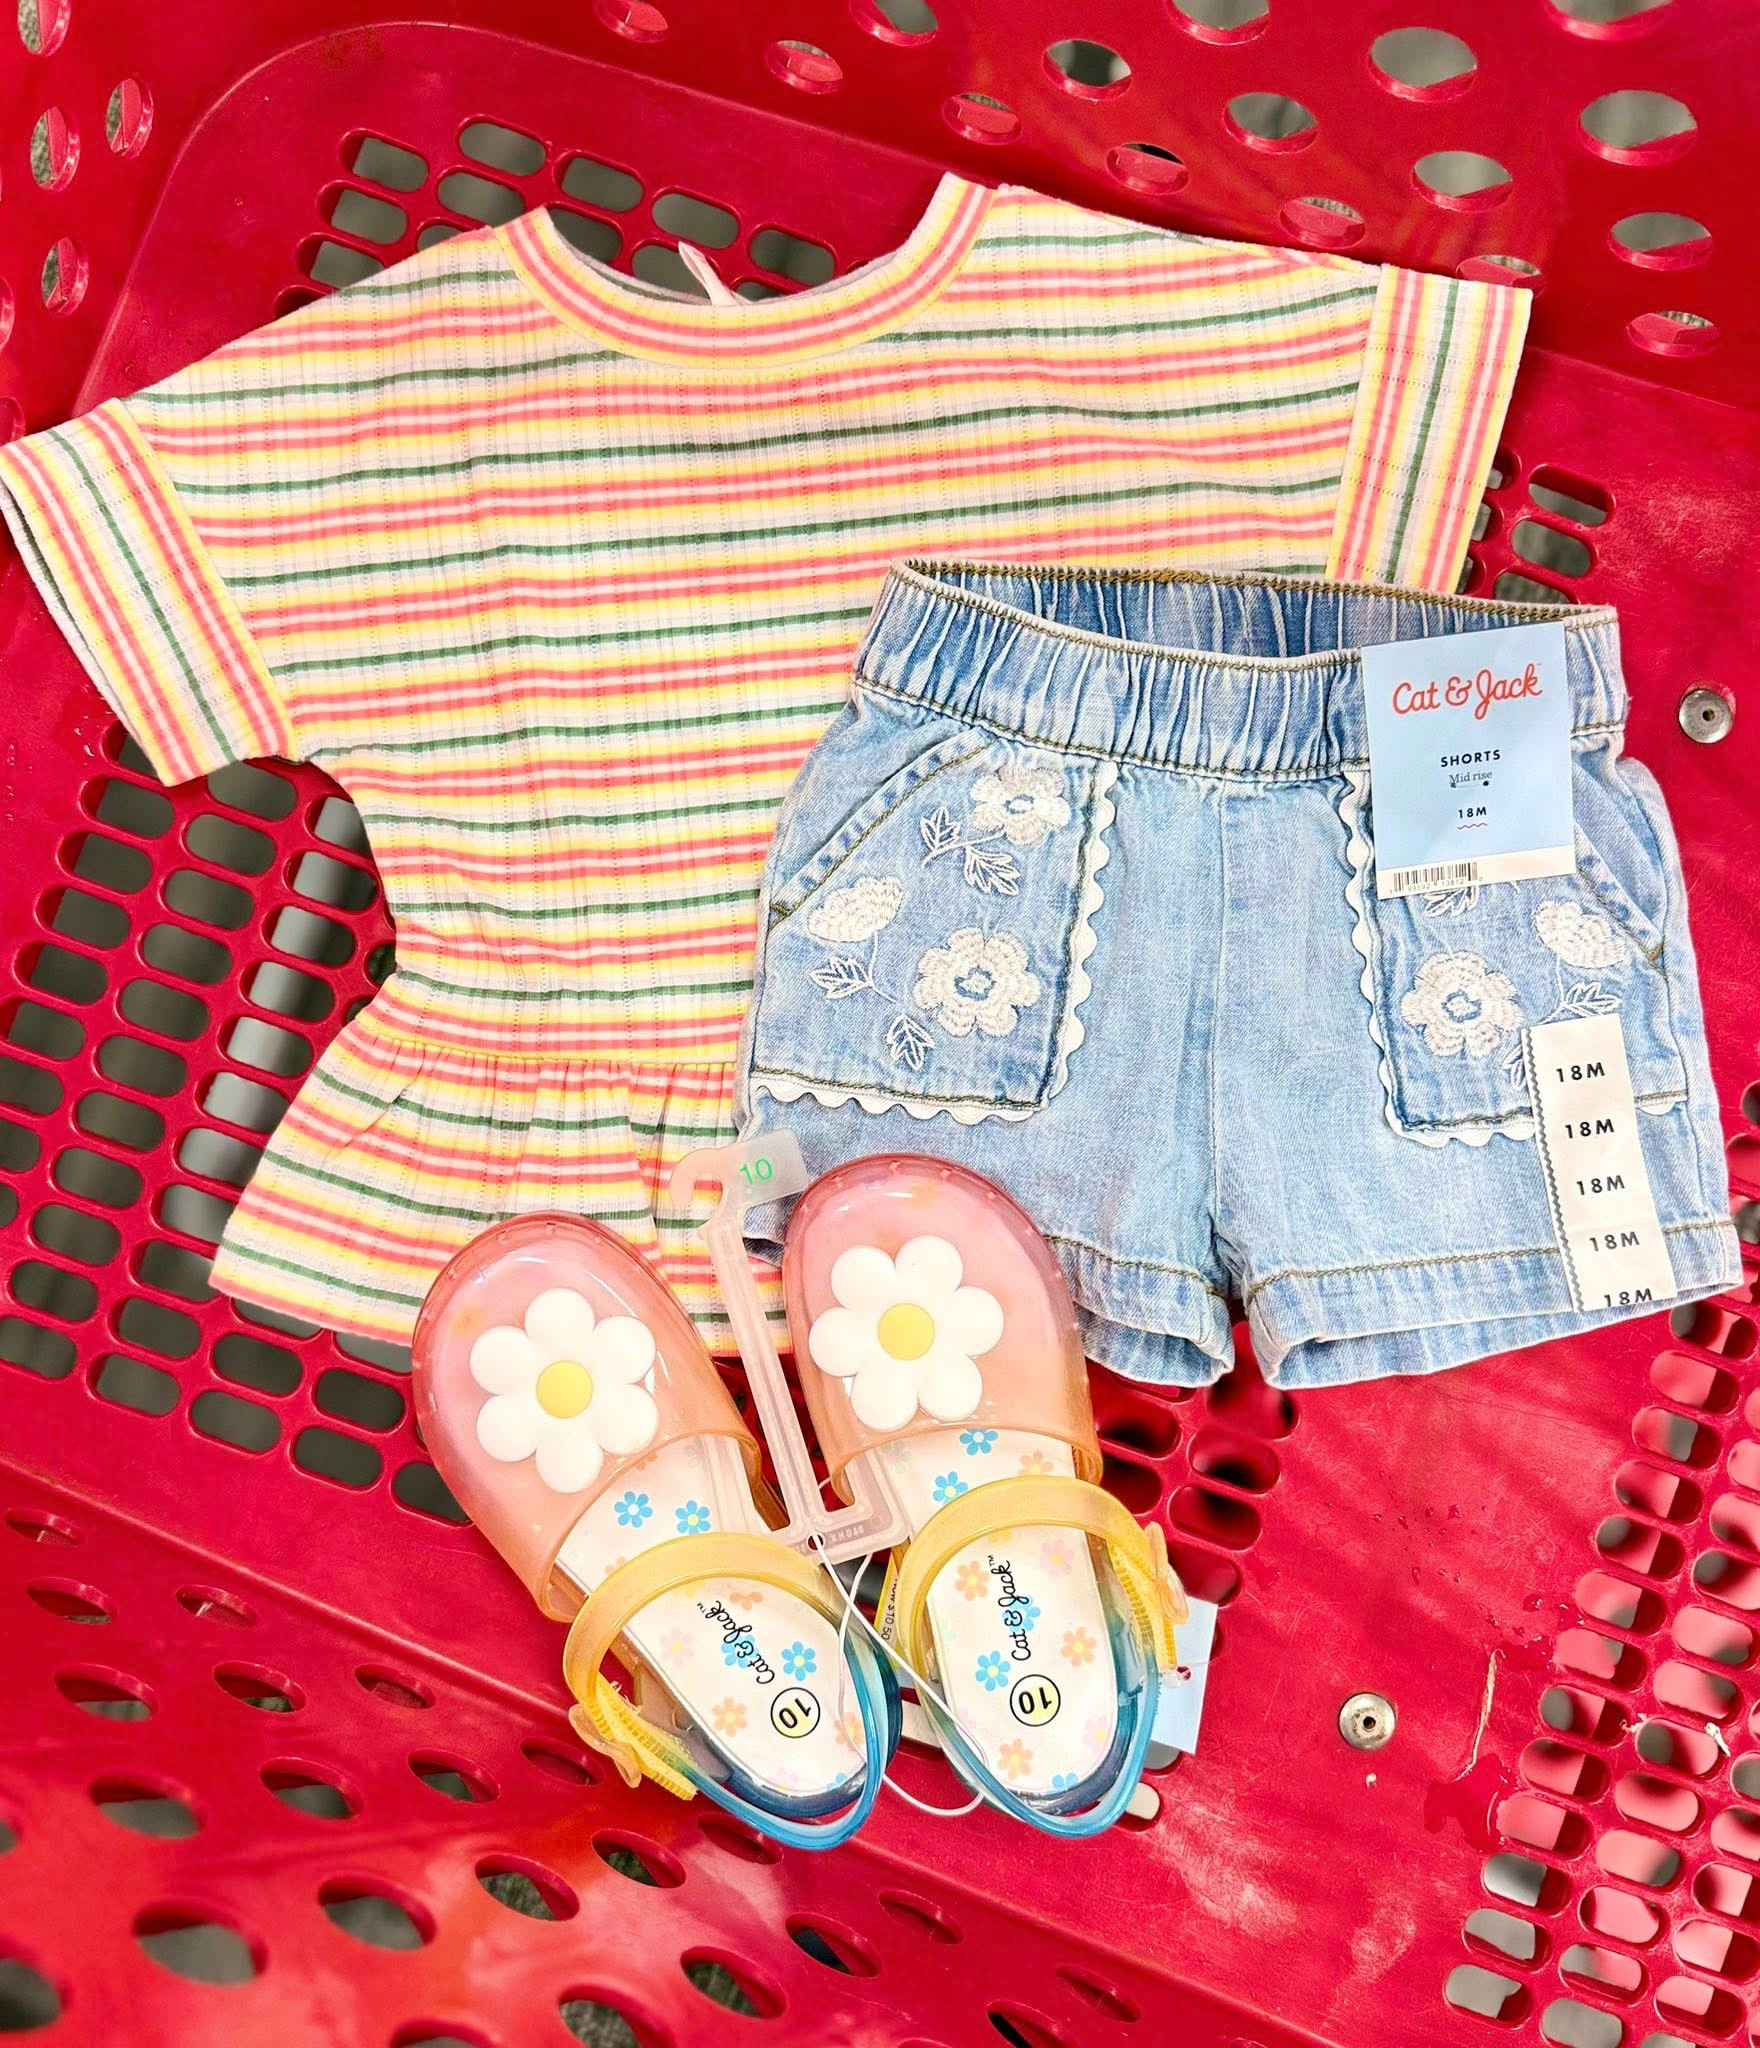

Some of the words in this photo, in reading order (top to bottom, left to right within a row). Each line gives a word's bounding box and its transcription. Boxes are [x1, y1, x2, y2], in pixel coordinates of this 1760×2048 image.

[1392, 682, 1441, 715] Cat
[1445, 676, 1472, 706] &
[1474, 663, 1543, 720] Jack
[1440, 749, 1501, 768] SHORTS
[1449, 772, 1470, 784] Mid
[1472, 771, 1493, 781] rise
[1458, 806, 1487, 819] 18M
[1556, 1062, 1605, 1083] 18M
[1564, 1118, 1615, 1139] 18M
[740, 1158, 773, 1185] 10
[1576, 1175, 1625, 1196] 18M
[1589, 1231, 1640, 1252] 18M
[1603, 1288, 1652, 1307] 18M
[1004, 1609, 1023, 1627] &
[734, 1640, 754, 1658] &
[1009, 1628, 1031, 1661] Cat
[747, 1653, 775, 1685] Cat
[1018, 1686, 1052, 1715] 10
[779, 1697, 812, 1729] 10
